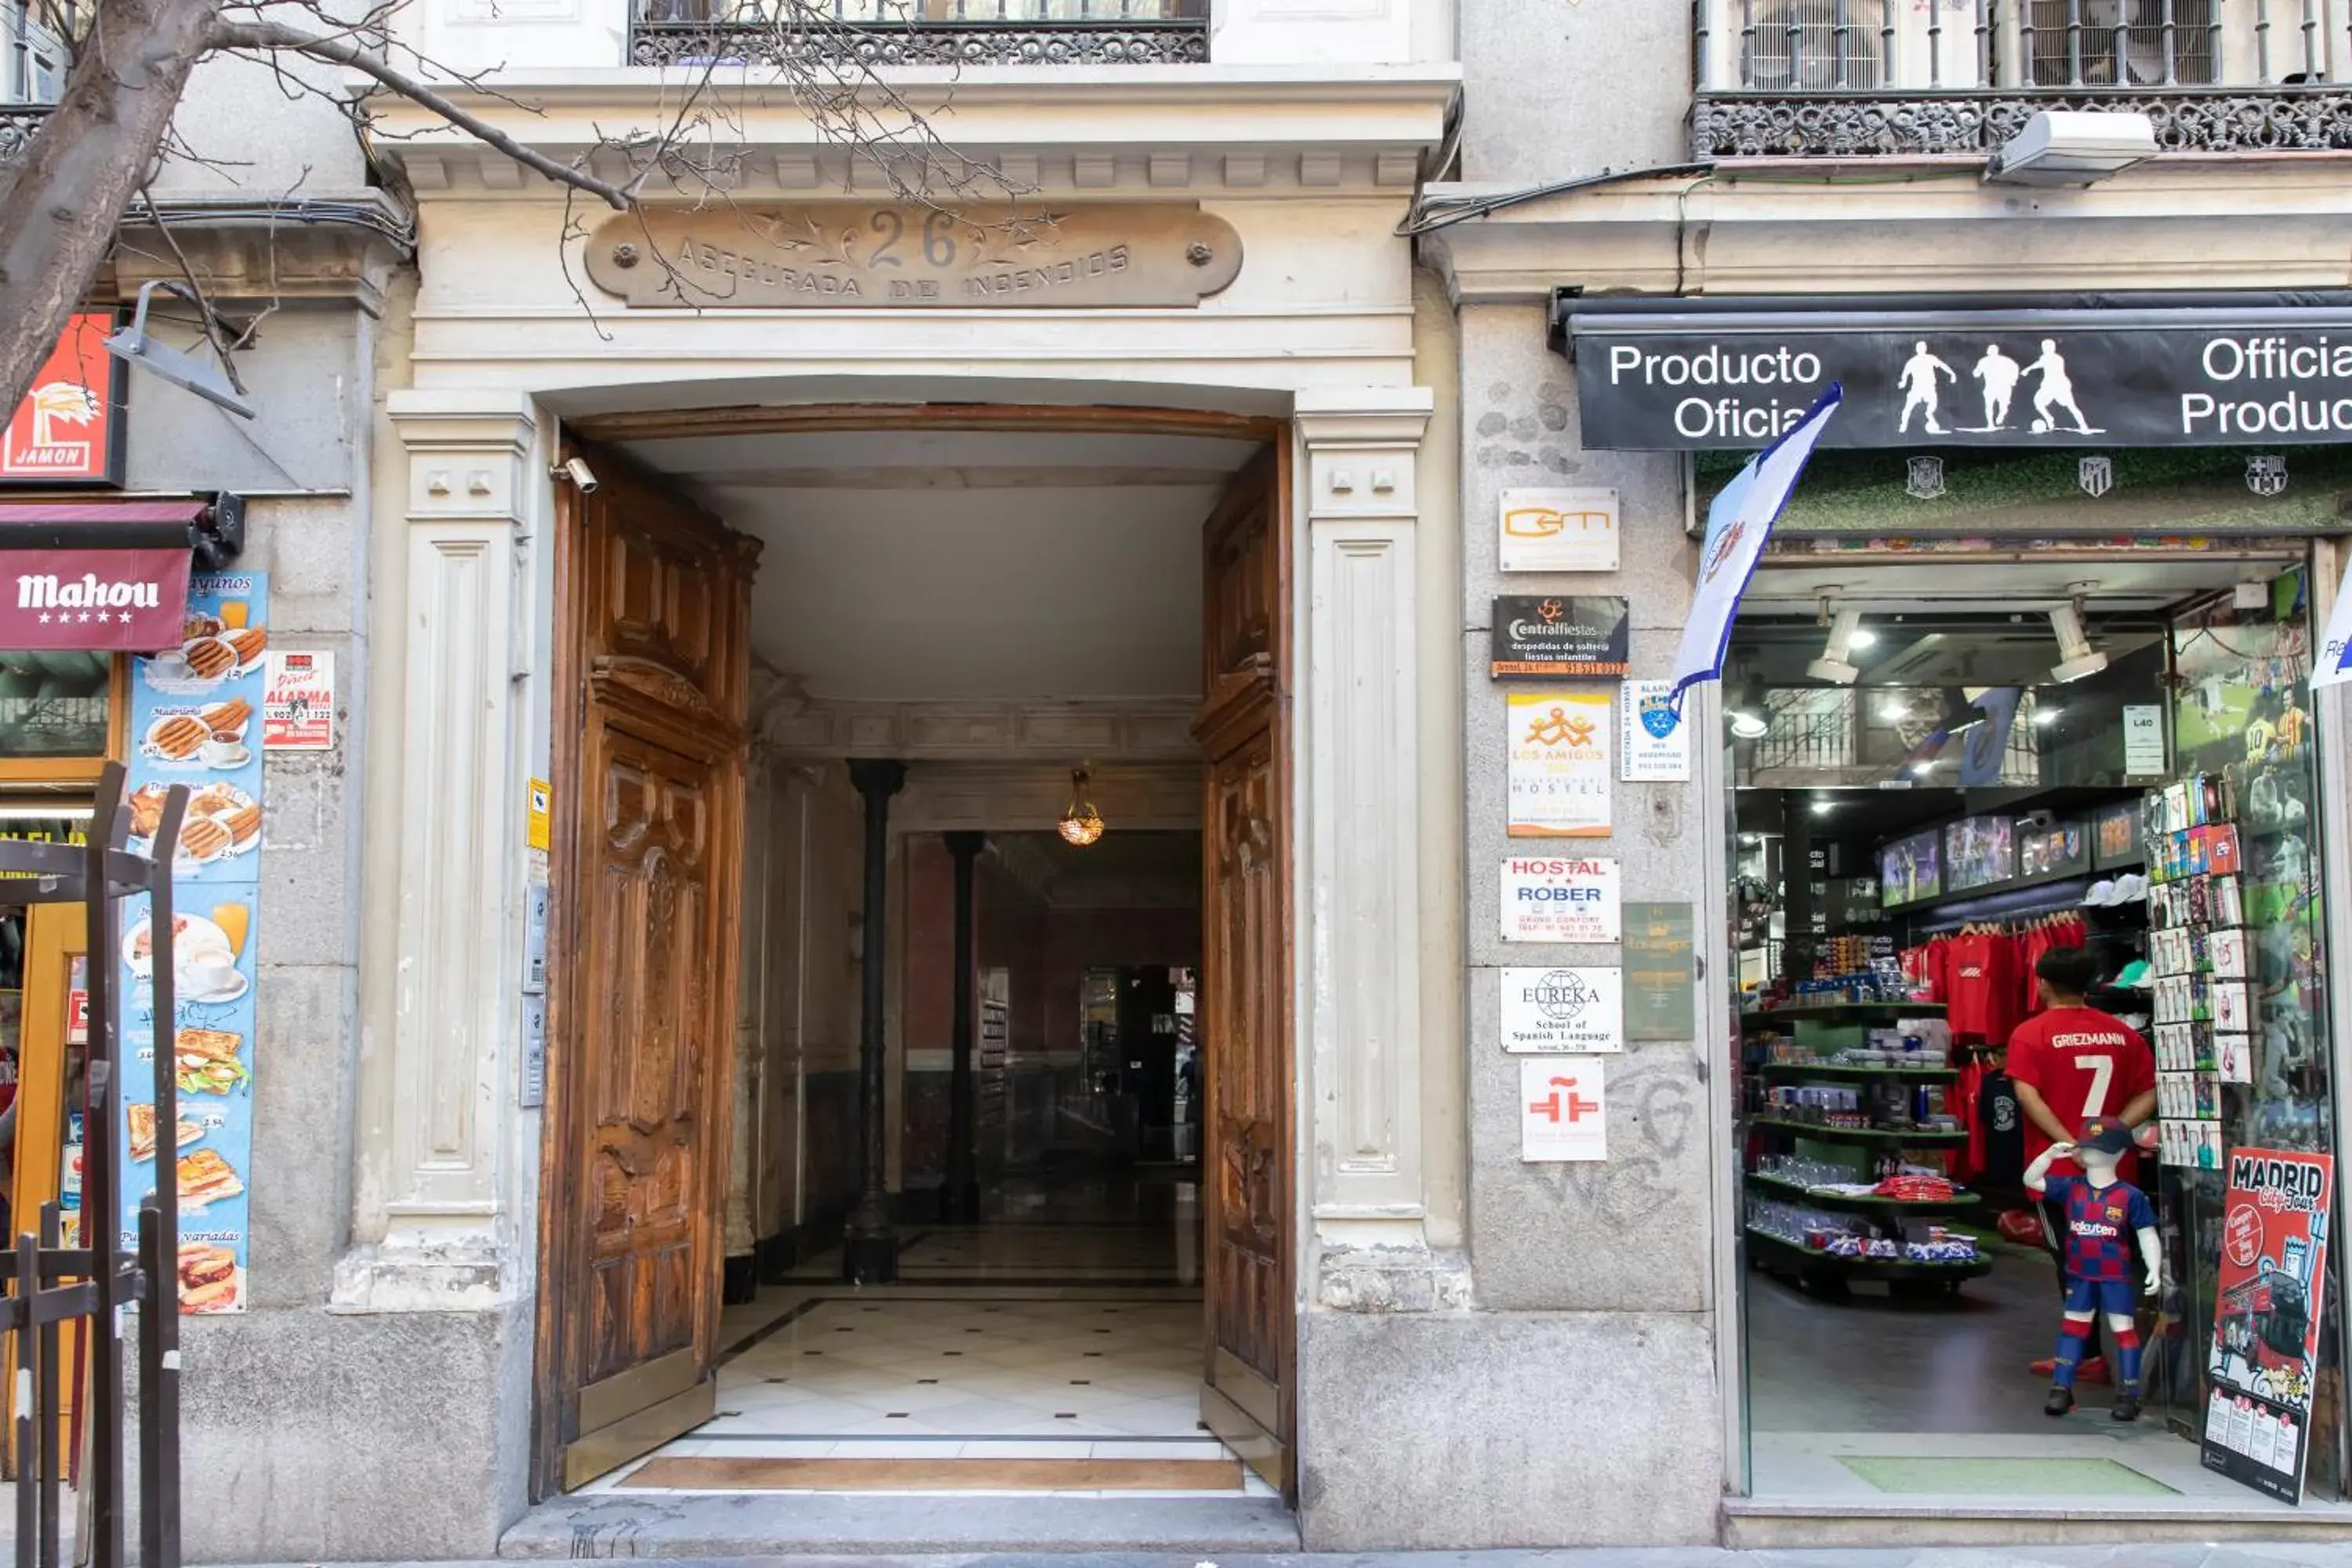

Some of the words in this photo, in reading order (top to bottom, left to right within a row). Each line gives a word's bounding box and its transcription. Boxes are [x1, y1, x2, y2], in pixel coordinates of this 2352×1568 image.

[867, 210, 956, 268] 26
[678, 236, 863, 298] ASEGURADA
[888, 279, 938, 299] DE
[965, 244, 1129, 297] INCENDIOS
[1610, 345, 1821, 384] Producto
[1674, 397, 1818, 437] Oficia
[2182, 390, 2352, 434] Produc
[16, 573, 160, 608] Mahou
[190, 577, 252, 598] ayunos
[1512, 642, 1561, 651] despedidas
[266, 691, 330, 703] ALARMA
[1545, 750, 1603, 760] AMIGOS
[1512, 784, 1603, 794] HOSTEL
[1512, 860, 1606, 875] HOSTAL
[1517, 887, 1601, 902] ROBER
[1523, 987, 1601, 1004] EUREKA
[1512, 1031, 1553, 1041] Spanish
[1561, 1031, 1610, 1041] Language
[2052, 1033, 2126, 1047] GRIEZMANN
[2074, 1055, 2114, 1117] 7
[2233, 1158, 2323, 1196] MADRID
[183, 1232, 239, 1241] variadas
